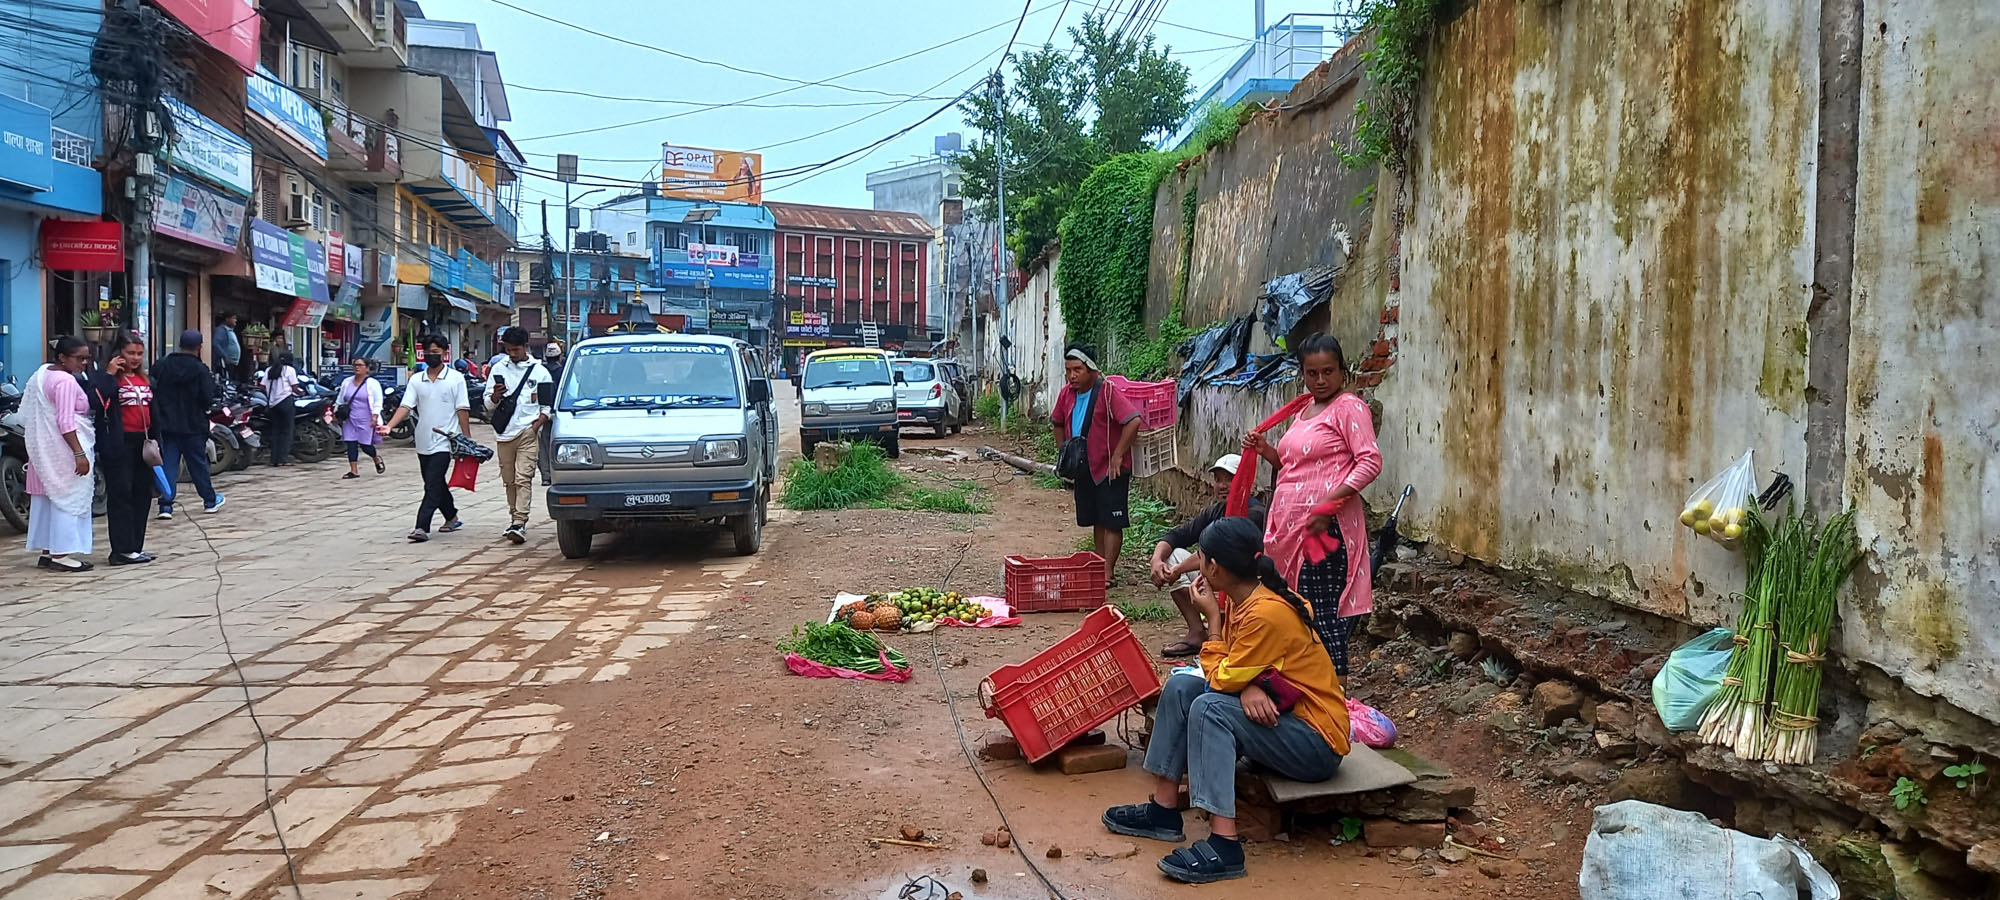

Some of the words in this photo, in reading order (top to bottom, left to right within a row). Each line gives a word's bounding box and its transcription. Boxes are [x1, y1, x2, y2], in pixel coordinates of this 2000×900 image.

[3, 130, 24, 150] पाल्पा
[25, 137, 44, 156] शाखा
[686, 152, 713, 164] OPAL
[600, 395, 699, 407] SUZUKI
